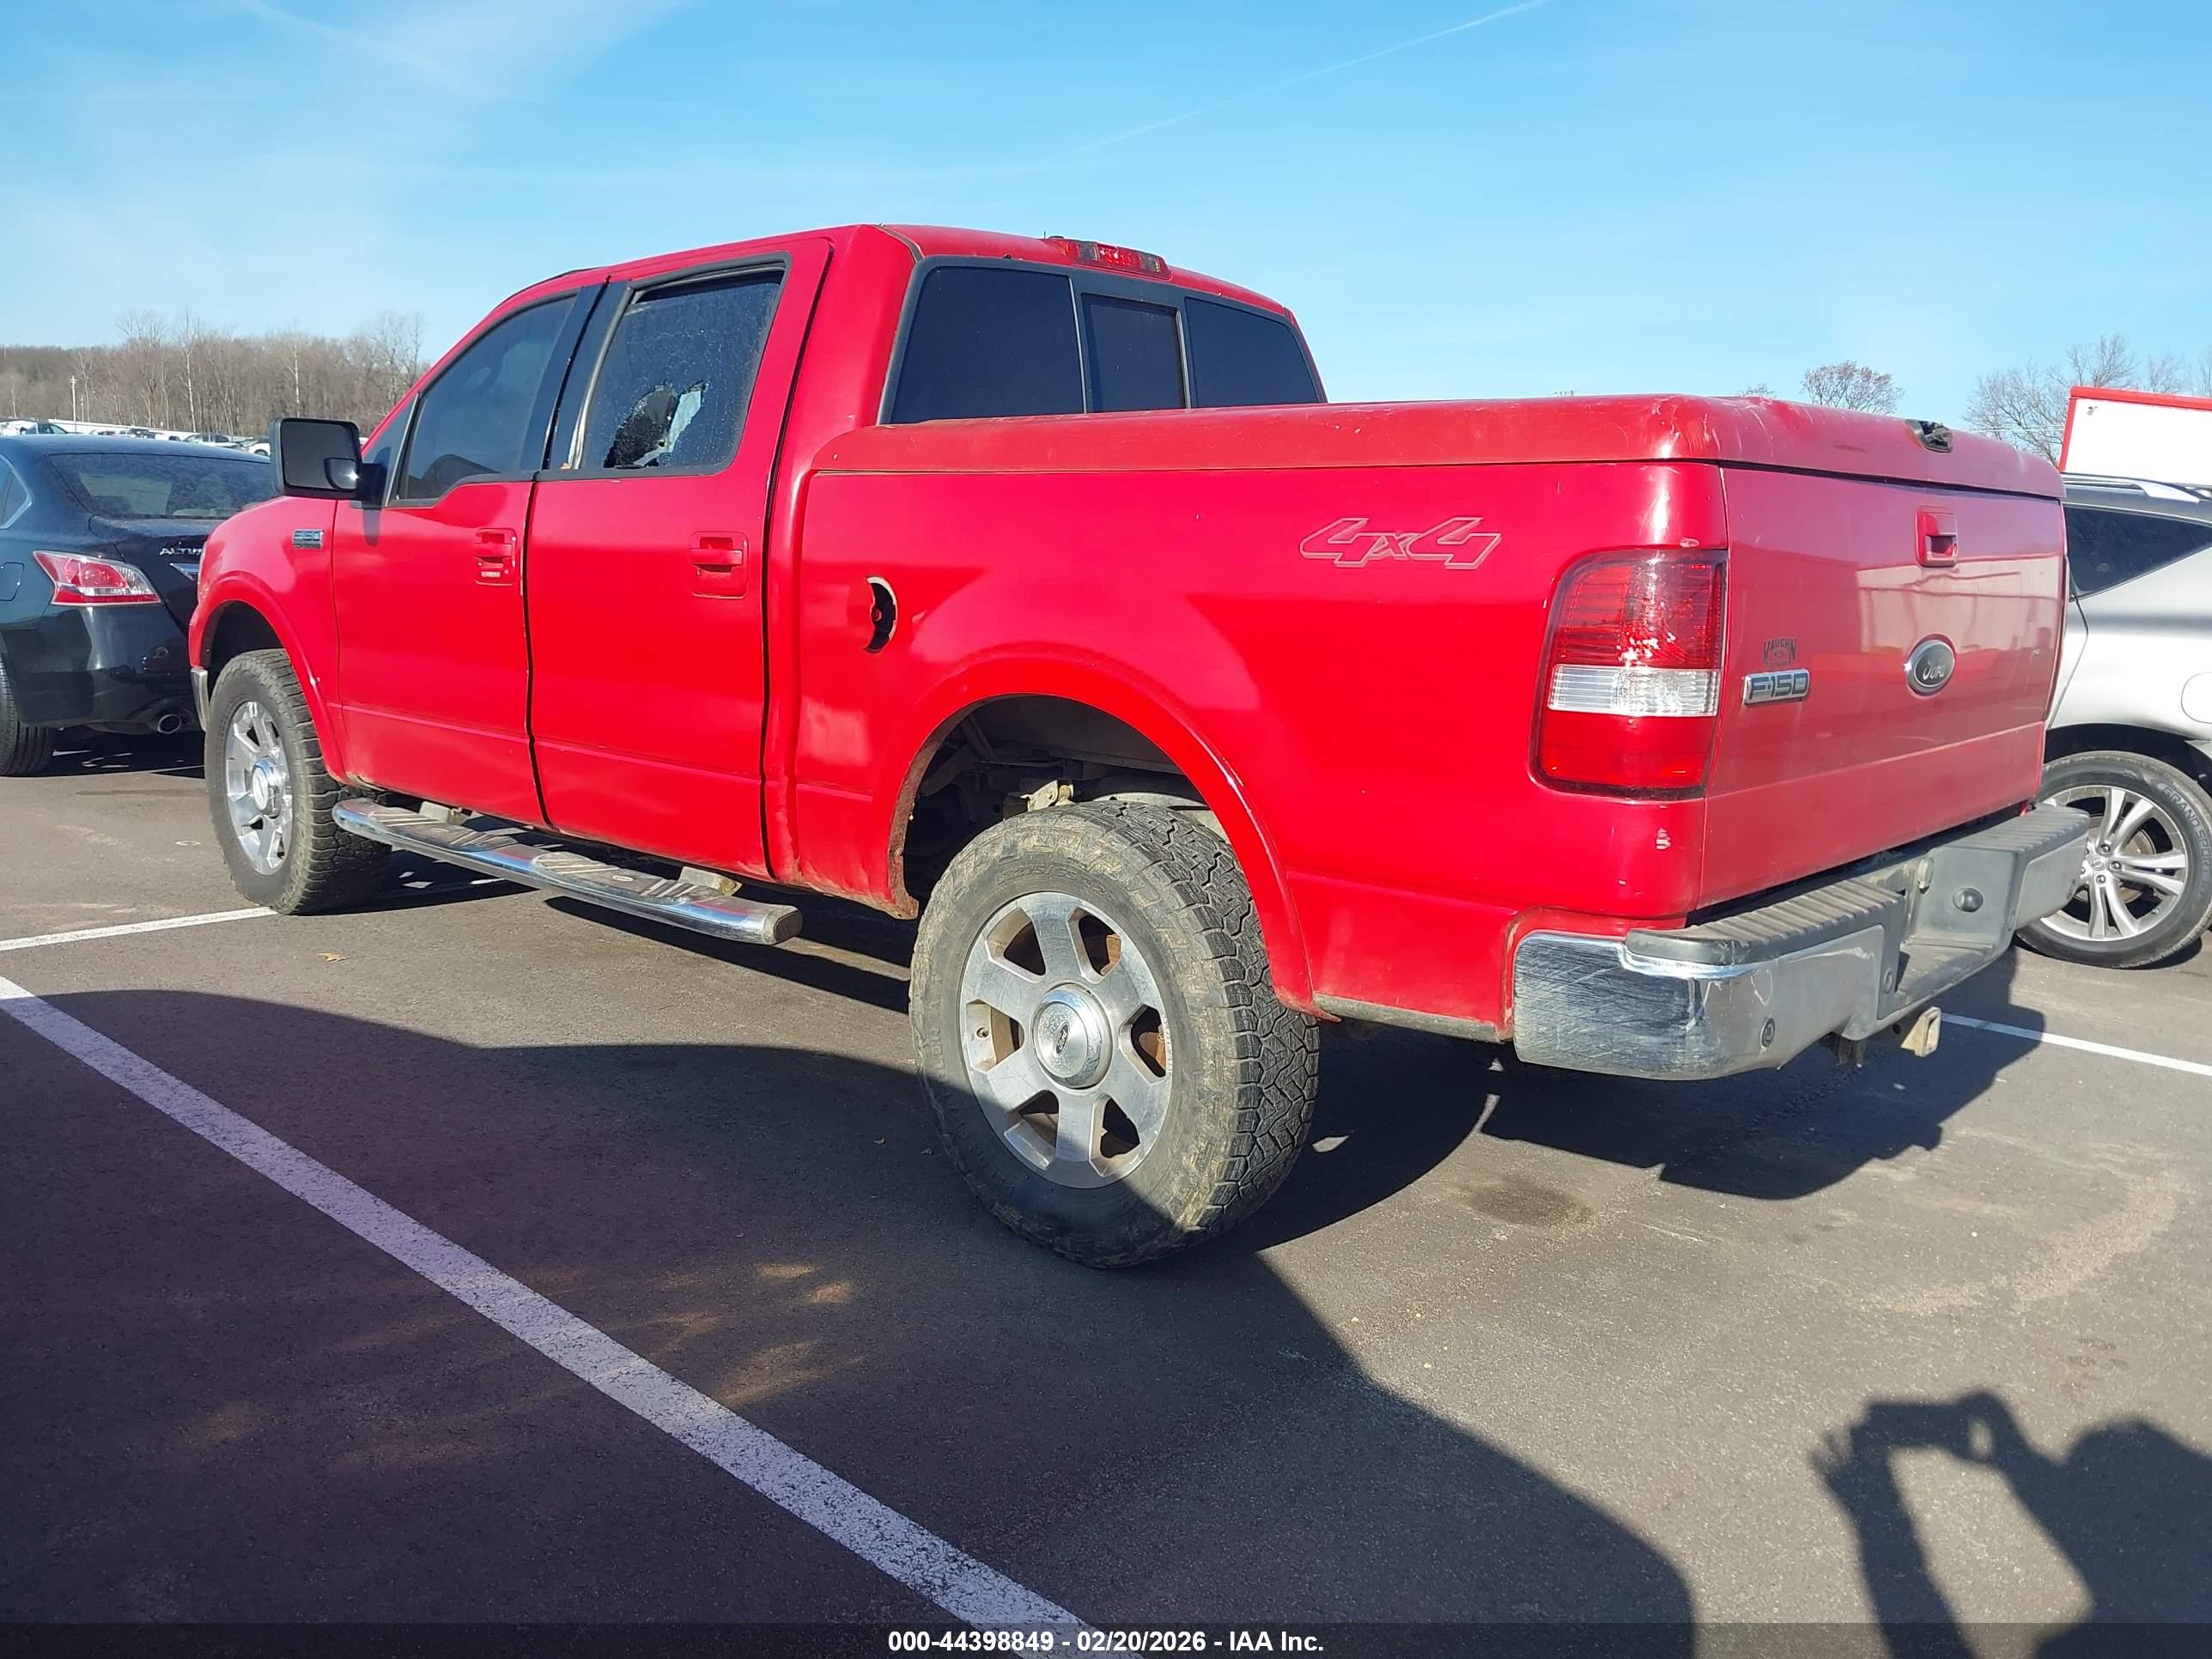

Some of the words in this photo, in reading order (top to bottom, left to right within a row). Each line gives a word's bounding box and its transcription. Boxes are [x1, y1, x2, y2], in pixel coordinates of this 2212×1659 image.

[159, 547, 204, 556] ALTIM
[1299, 516, 1503, 570] 4x4
[1763, 638, 1796, 666] VAUGHN
[1748, 672, 1808, 700] F-150
[2163, 787, 2201, 828] GRAND
